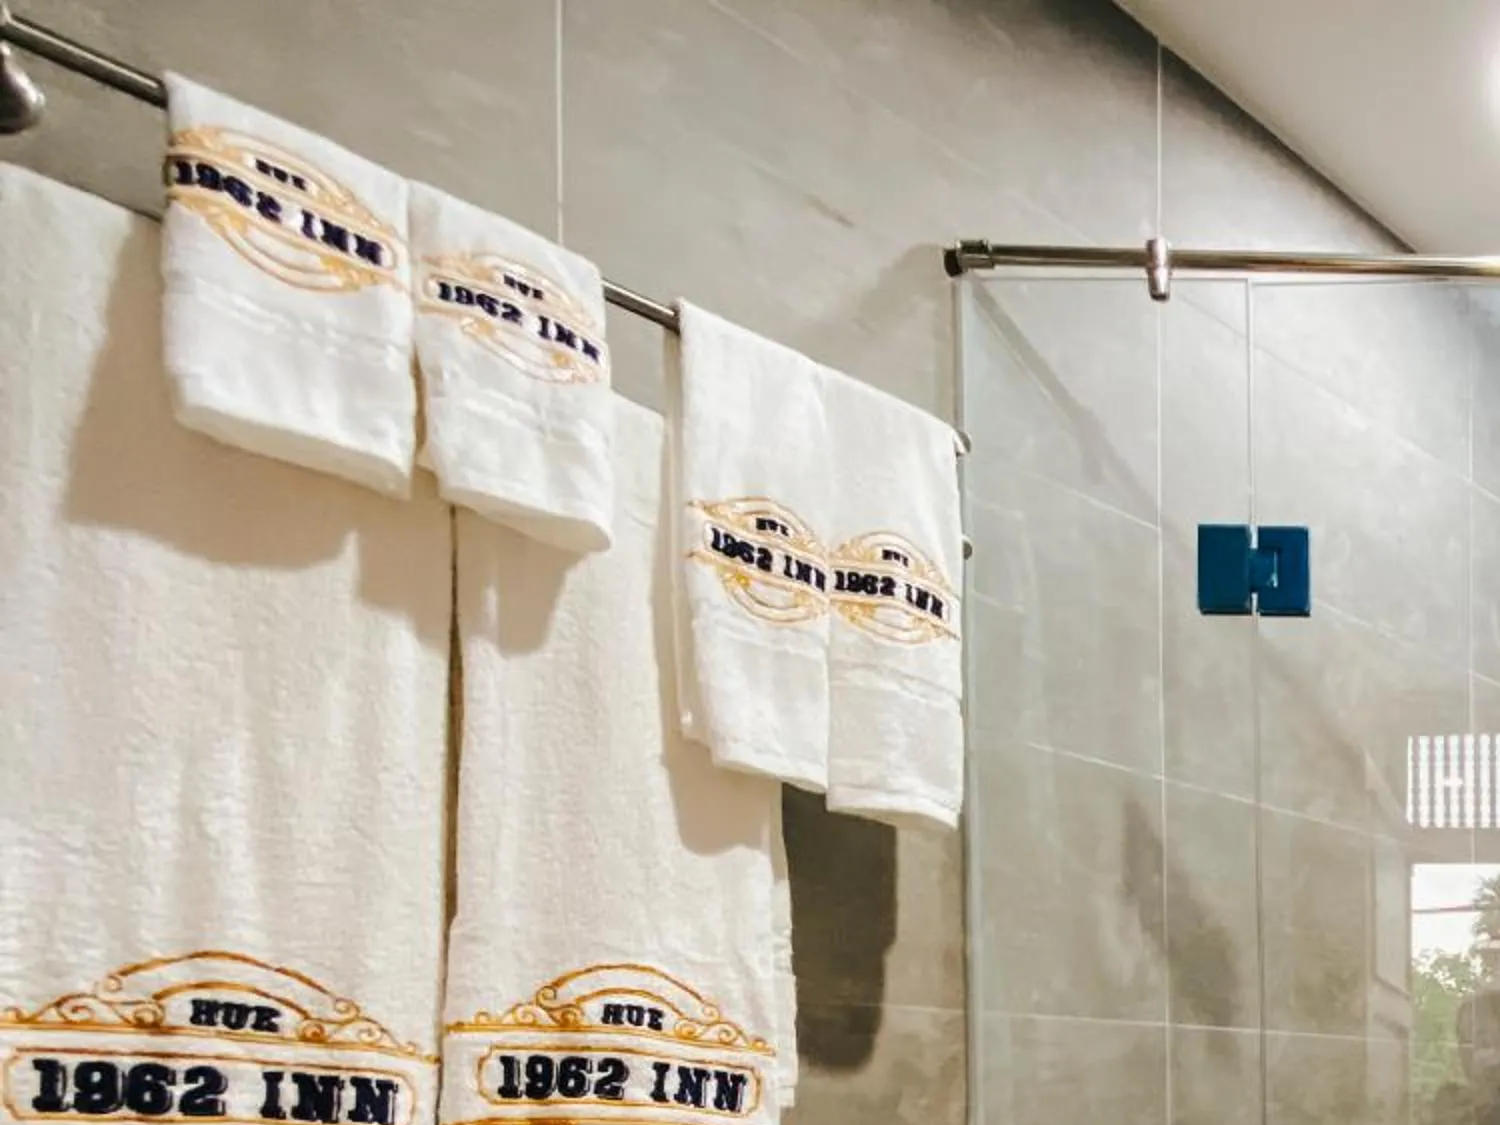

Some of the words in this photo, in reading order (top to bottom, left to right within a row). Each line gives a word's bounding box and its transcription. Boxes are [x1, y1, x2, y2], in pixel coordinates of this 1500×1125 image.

[438, 281, 524, 326] 1962
[710, 527, 774, 573] 1962
[834, 570, 896, 597] 1962
[189, 999, 281, 1034] HUE
[601, 1003, 665, 1031] HUE
[32, 1057, 228, 1117] 1962
[497, 1054, 630, 1101] 1962
[649, 1061, 748, 1112] INN
